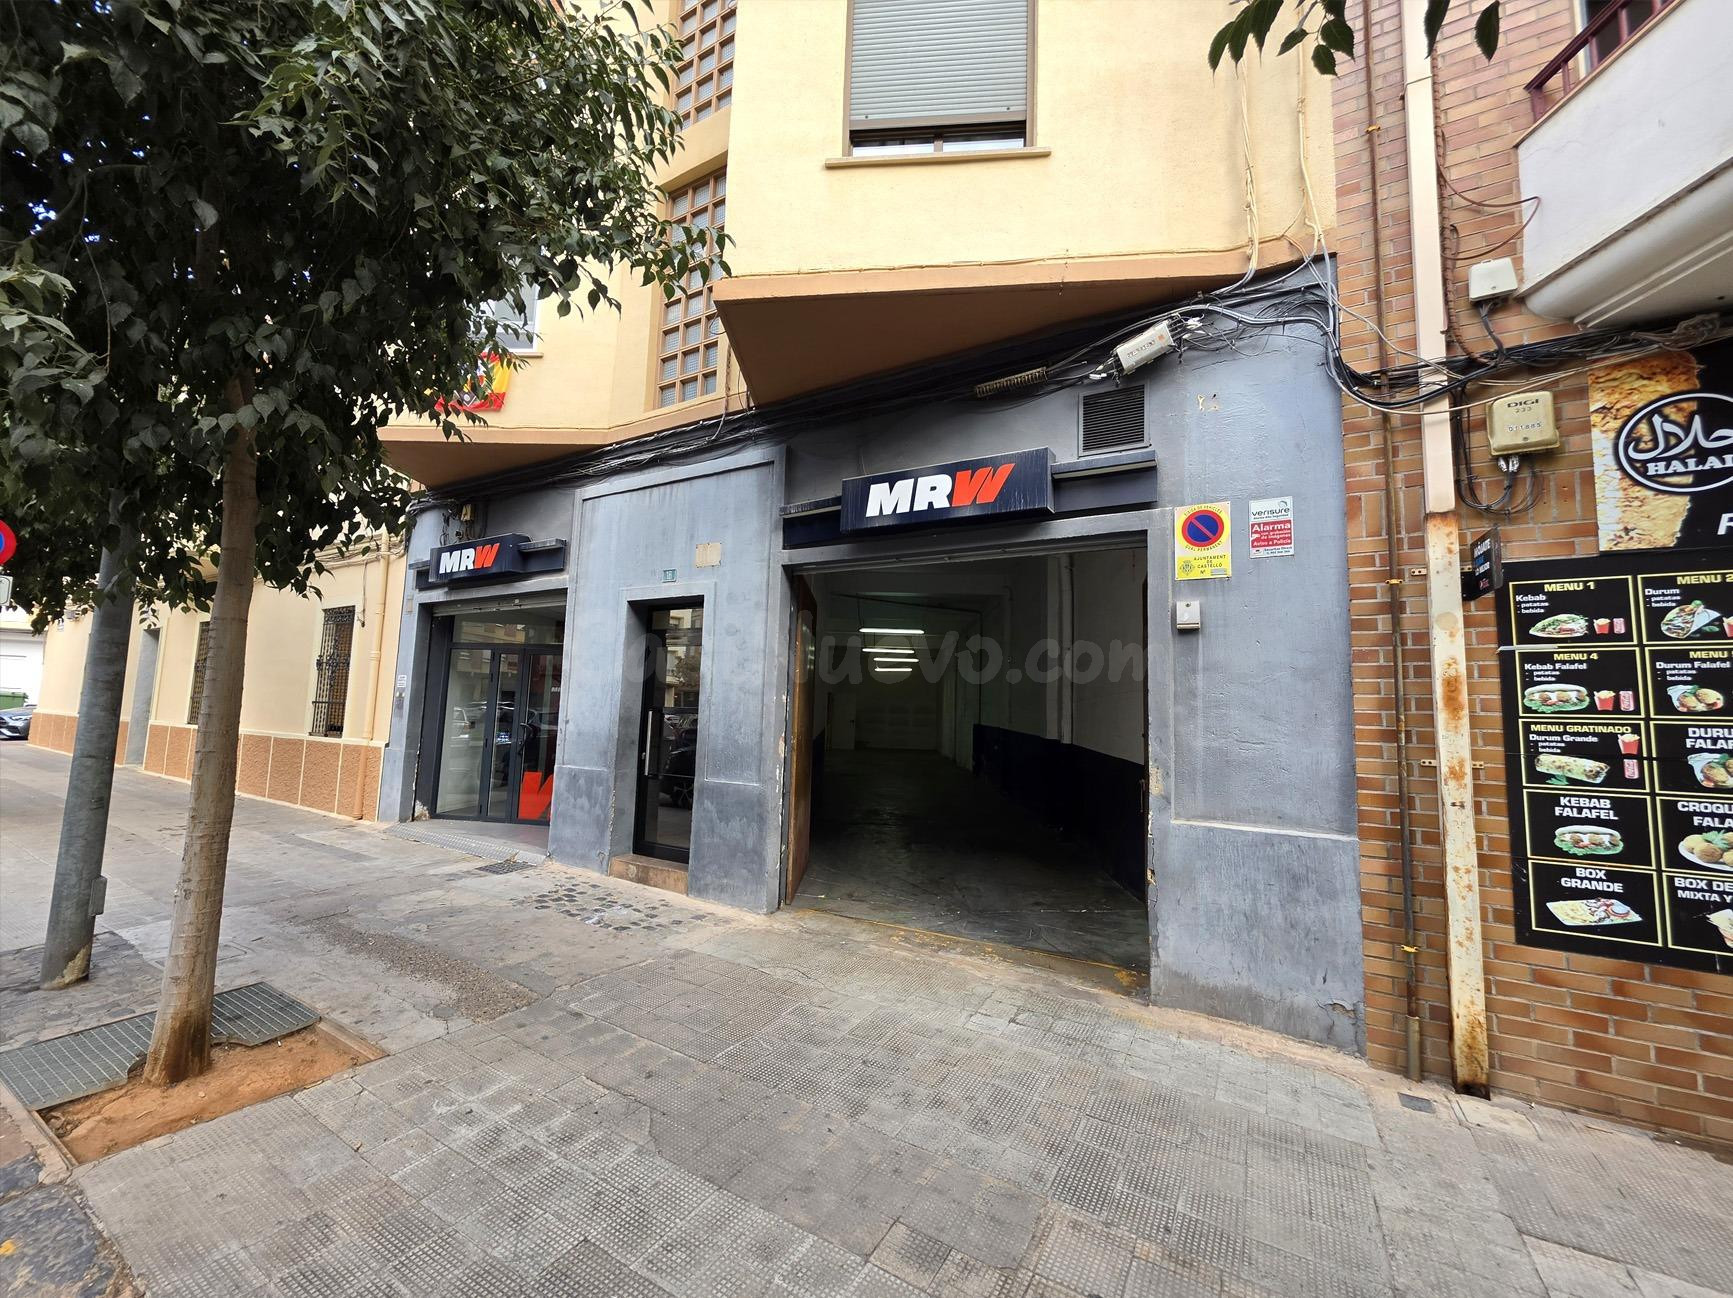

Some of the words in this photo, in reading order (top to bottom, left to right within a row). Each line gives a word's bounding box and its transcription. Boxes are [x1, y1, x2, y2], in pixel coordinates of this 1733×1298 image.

[1507, 399, 1539, 408] DIGI
[865, 463, 1016, 518] MRW
[1252, 507, 1290, 517] verisure
[1252, 522, 1291, 532] Alarma
[439, 543, 500, 574] MRW
[1676, 574, 1721, 585] MENU
[1544, 582, 1584, 592] MENU
[1586, 581, 1595, 590] 1
[1515, 594, 1547, 602] Kebab
[1553, 653, 1588, 661] MENU
[1589, 652, 1599, 660] 4
[1689, 651, 1728, 659] MENU
[1555, 662, 1588, 670] Falafel
[1655, 661, 1692, 669] Durum
[1530, 724, 1564, 732] MENU
[1566, 725, 1632, 733] GRATINADO
[1562, 734, 1599, 742] Grande
[1560, 796, 1611, 809] KEBAB
[1554, 806, 1619, 820] FALAFEL
[1575, 868, 1606, 880] BOX
[1560, 877, 1624, 893] GRANDE
[1674, 877, 1709, 889] BOX
[1712, 881, 1733, 892] DE
[1677, 890, 1721, 902] MIXTA
[1723, 895, 1733, 904] Y
